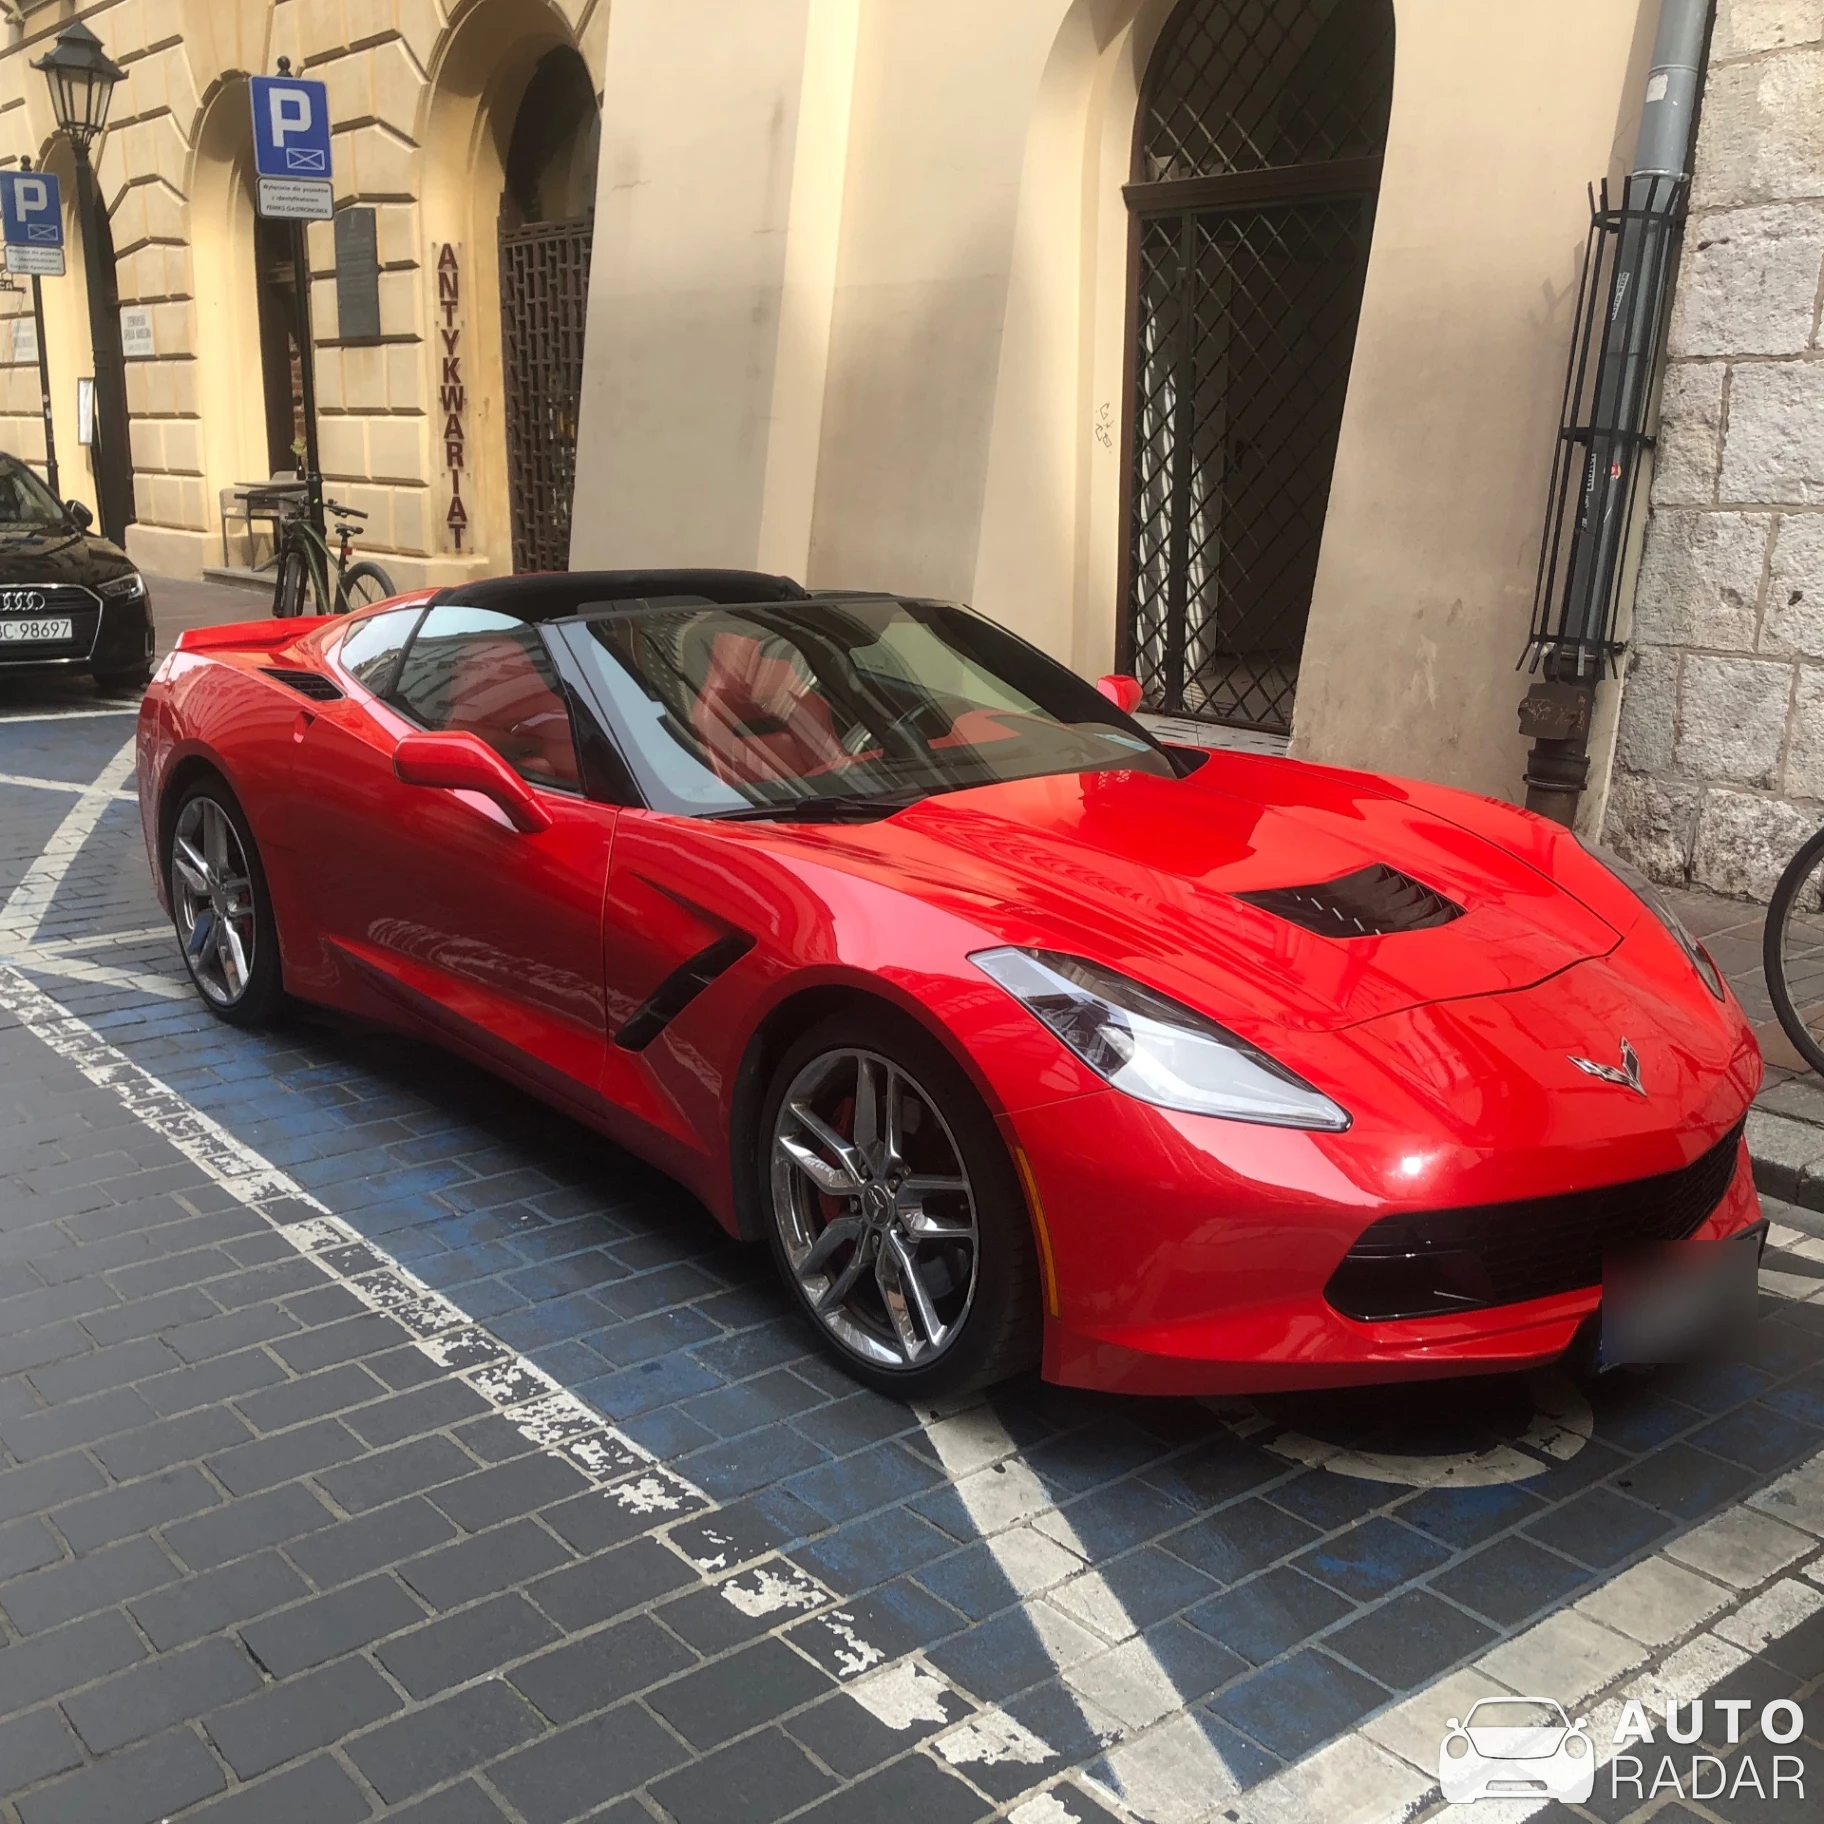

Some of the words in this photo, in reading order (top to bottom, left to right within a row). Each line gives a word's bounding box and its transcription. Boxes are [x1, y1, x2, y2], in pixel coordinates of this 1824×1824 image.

[269, 87, 312, 148] P
[13, 178, 48, 223] P
[437, 243, 468, 549] ANTYKWARIAT
[20, 621, 70, 639] 98697
